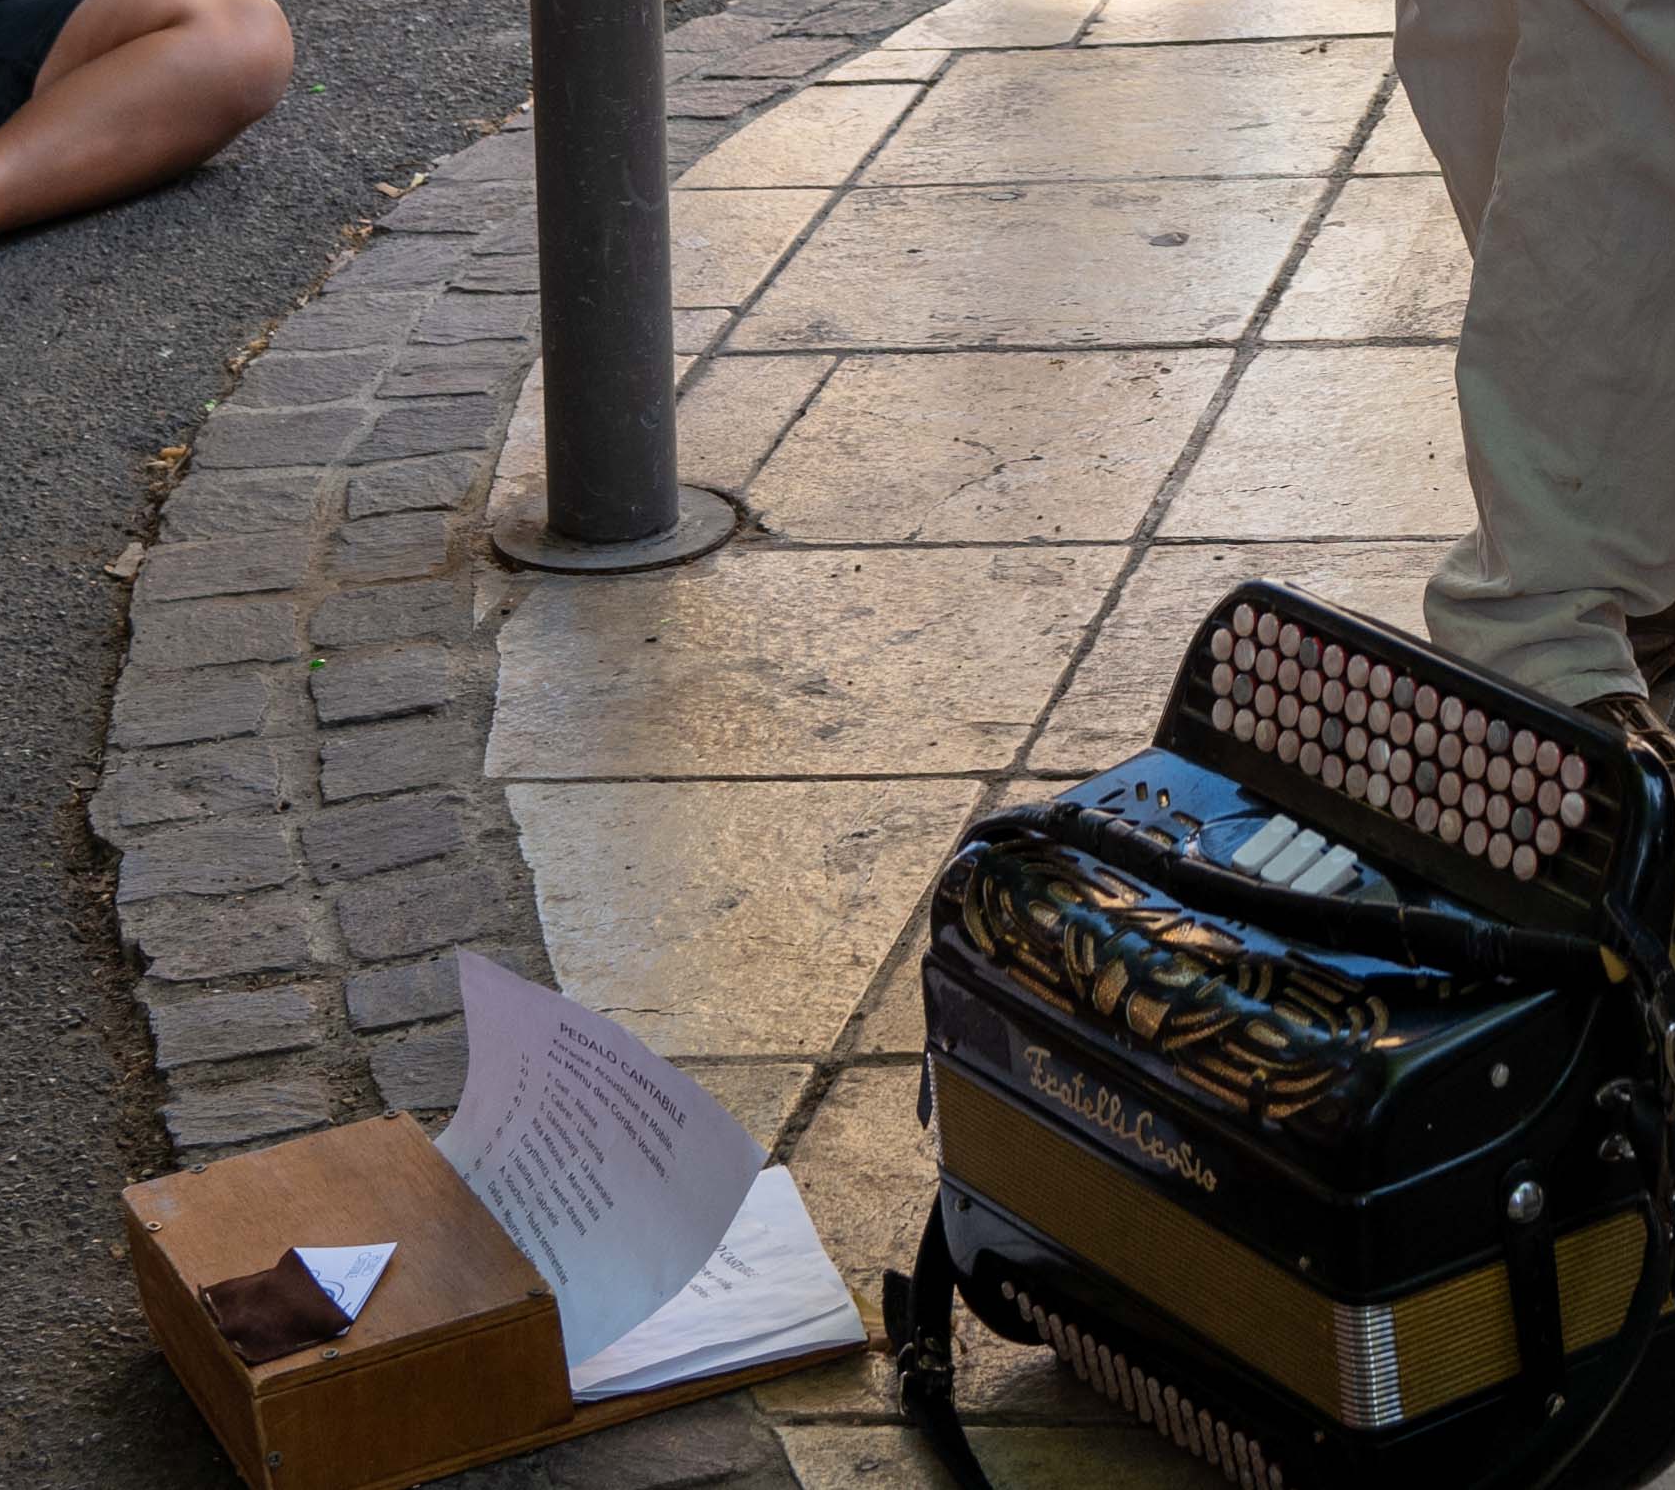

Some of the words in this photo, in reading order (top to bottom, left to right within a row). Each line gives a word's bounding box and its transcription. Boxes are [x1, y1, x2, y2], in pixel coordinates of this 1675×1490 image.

[560, 1022, 617, 1064] PEDALO
[620, 1061, 688, 1129] CANTABILE
[564, 1060, 592, 1089] Menu
[593, 1085, 609, 1107] des
[611, 1102, 637, 1140] Cordes
[637, 1135, 666, 1178] Vocales
[594, 1066, 641, 1112] Acoustique
[1024, 1044, 1132, 1140] Fratelli
